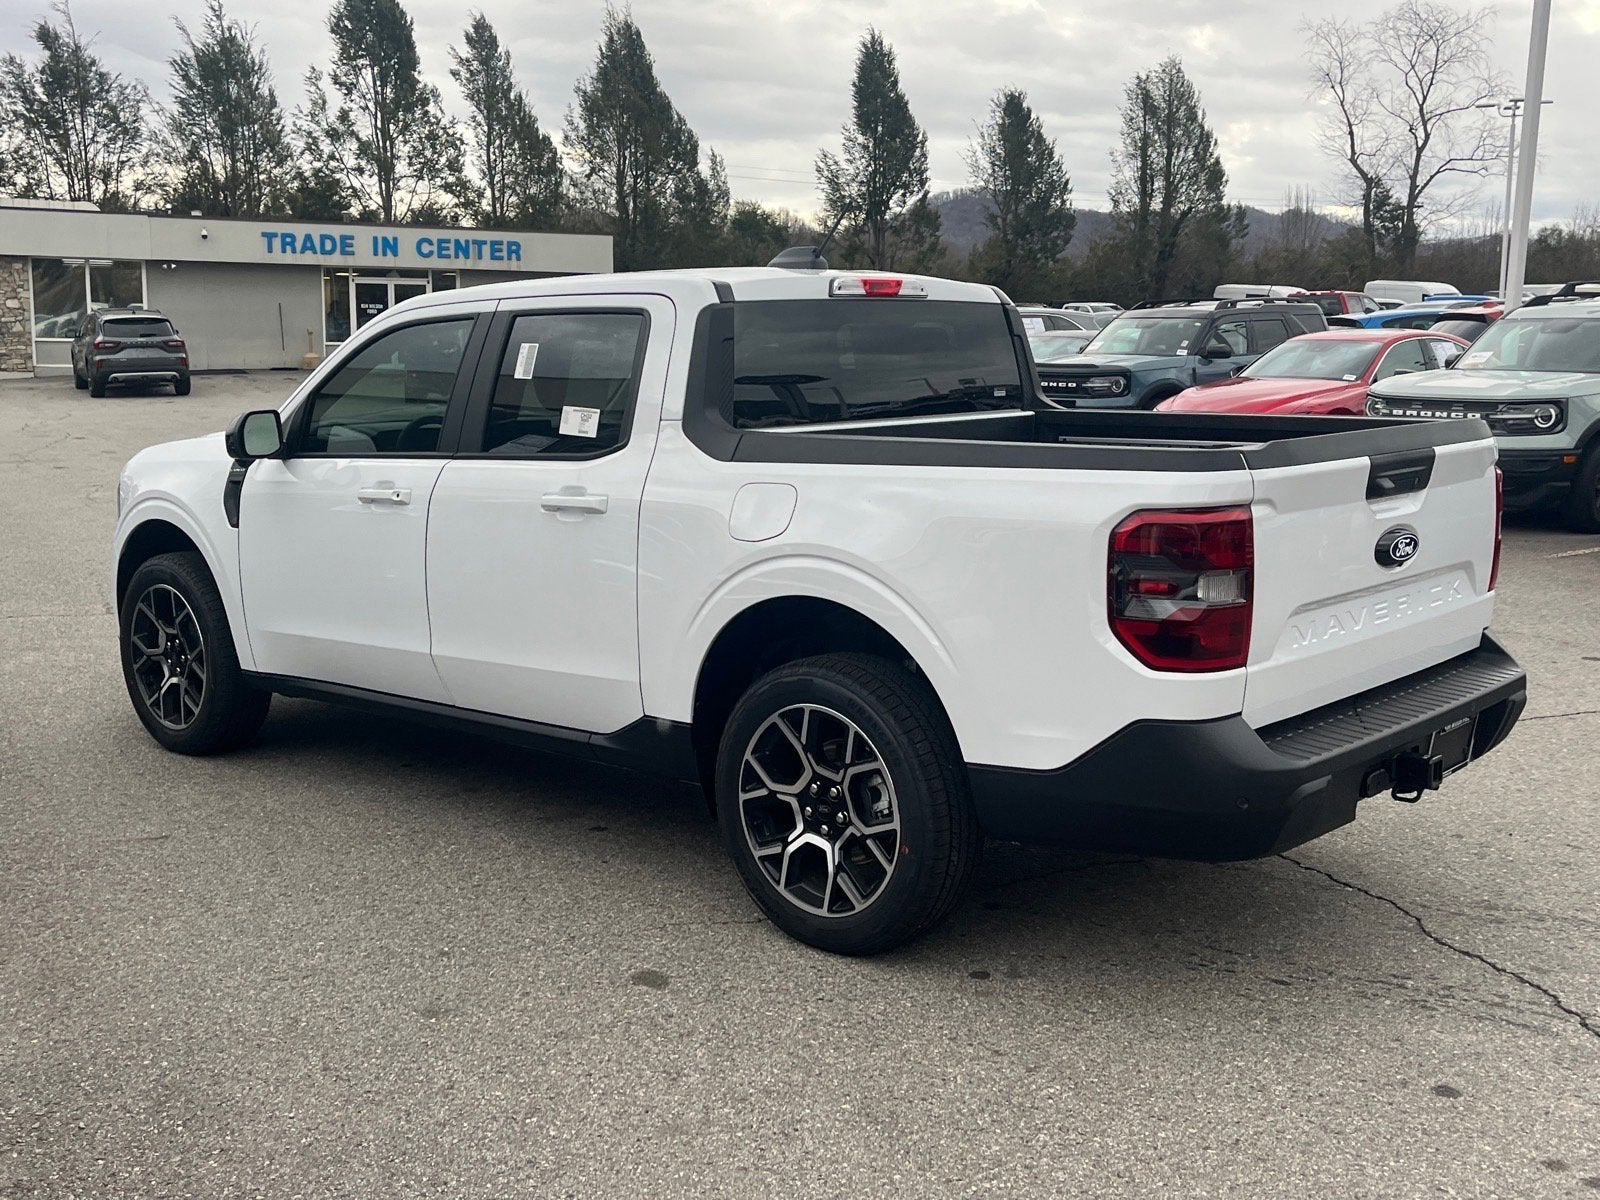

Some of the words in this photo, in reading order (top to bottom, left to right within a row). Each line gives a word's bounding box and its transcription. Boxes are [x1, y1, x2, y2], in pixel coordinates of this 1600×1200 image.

[261, 231, 355, 256] TRADE
[372, 235, 399, 257] IN
[415, 237, 522, 261] CENTER
[1392, 409, 1481, 419] BRONCO
[1291, 579, 1463, 648] MAVERICK
